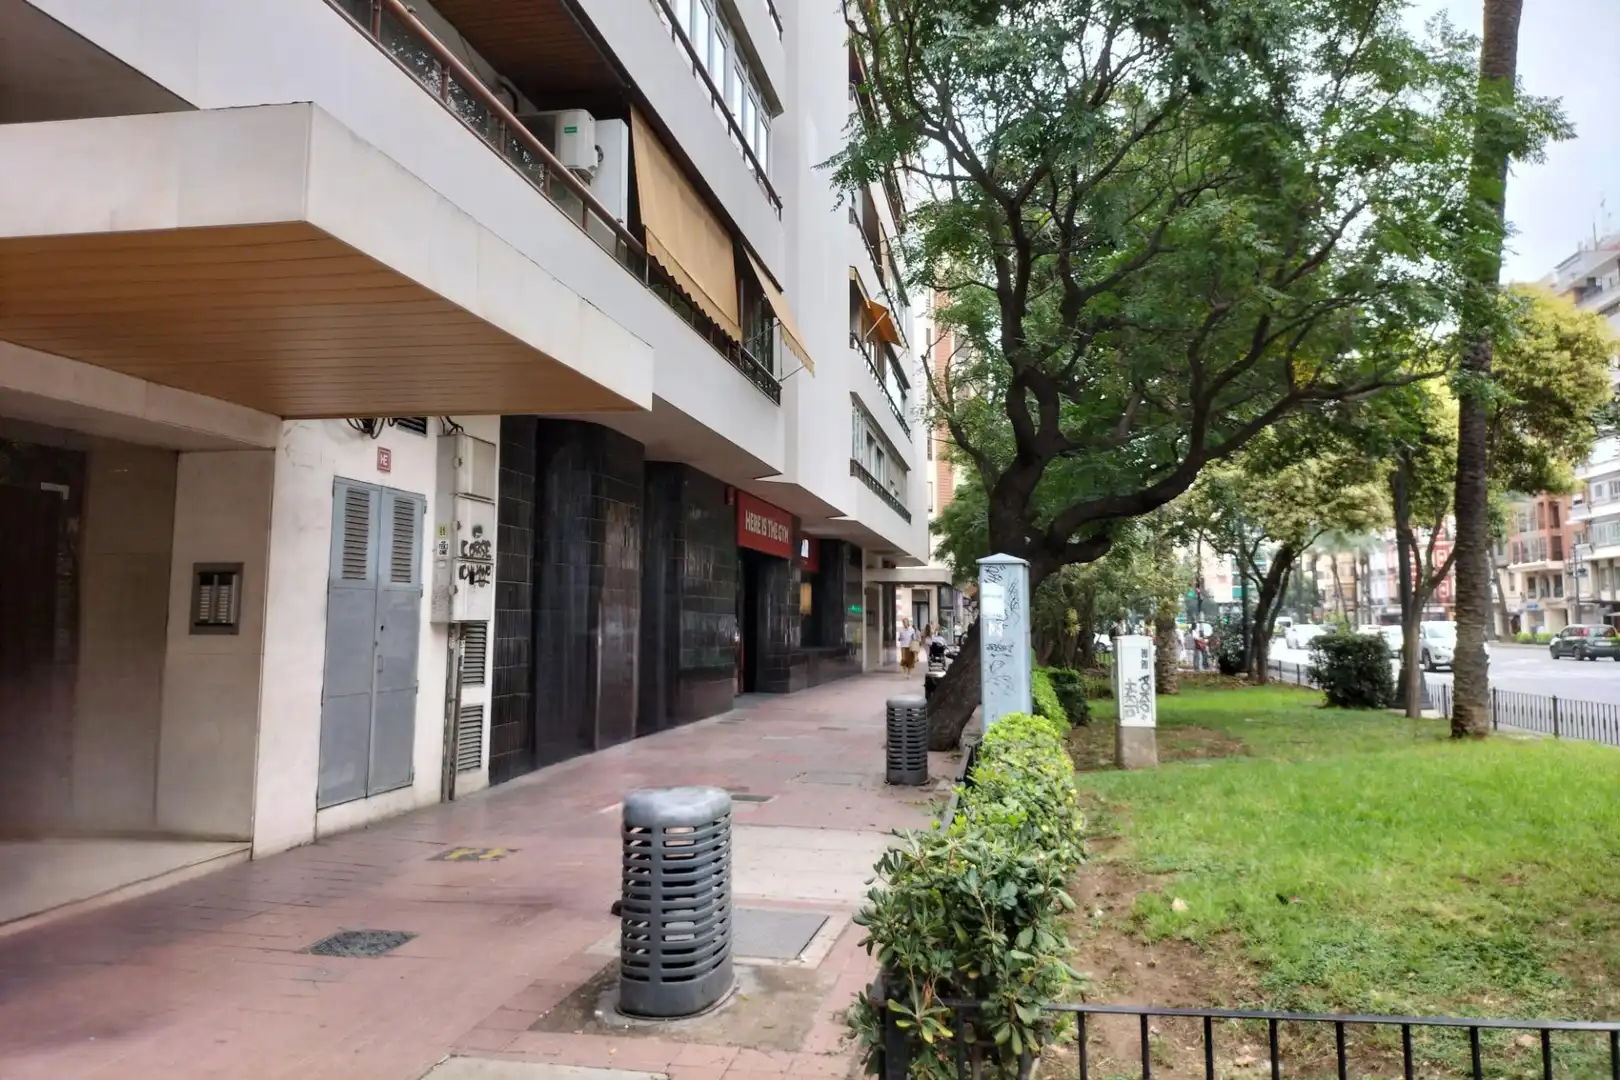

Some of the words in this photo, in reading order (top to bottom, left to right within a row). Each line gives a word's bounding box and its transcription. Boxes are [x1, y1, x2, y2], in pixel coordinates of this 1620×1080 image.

[745, 509, 761, 535] HERE
[767, 519, 778, 541] THE
[778, 524, 789, 545] GYM
